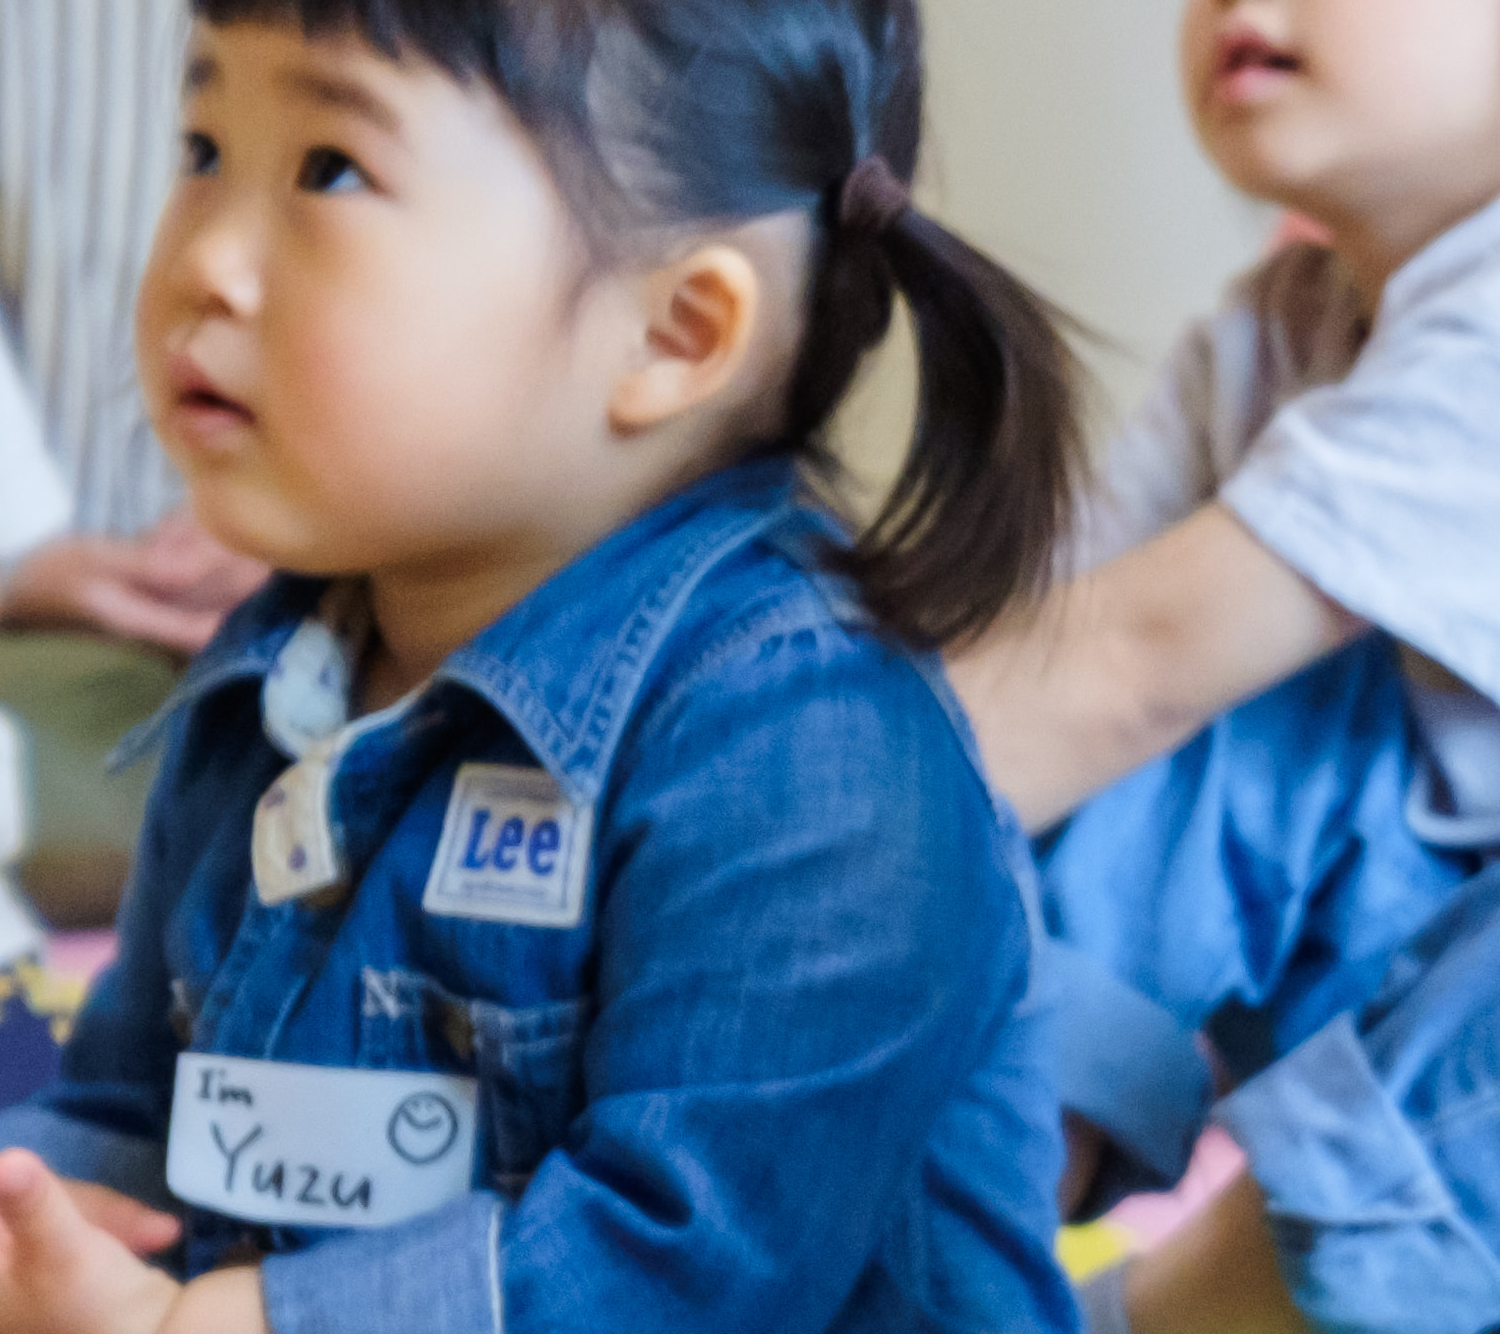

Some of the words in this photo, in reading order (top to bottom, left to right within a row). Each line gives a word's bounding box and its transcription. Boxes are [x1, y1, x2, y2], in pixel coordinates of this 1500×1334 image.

[463, 807, 561, 876] Lee
[196, 1068, 254, 1107] I'm
[210, 1121, 373, 1210] Yuzu
